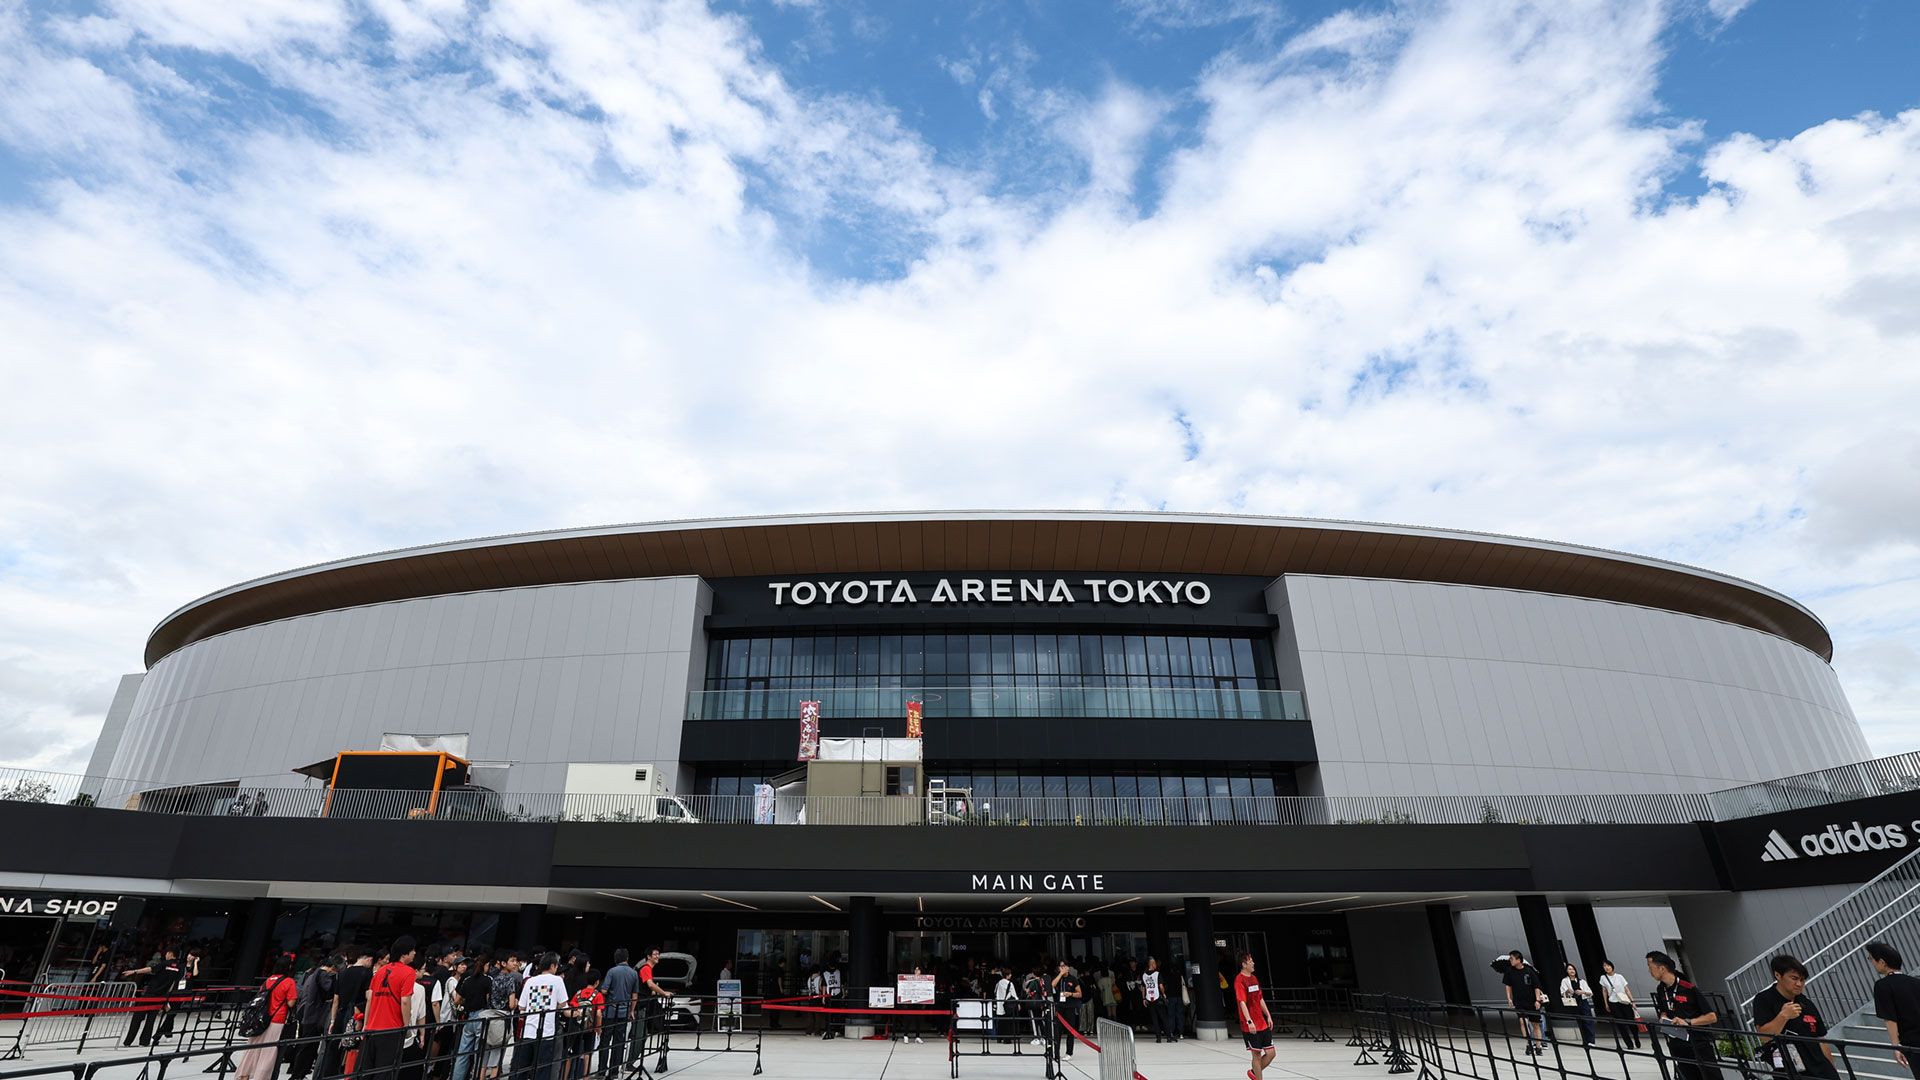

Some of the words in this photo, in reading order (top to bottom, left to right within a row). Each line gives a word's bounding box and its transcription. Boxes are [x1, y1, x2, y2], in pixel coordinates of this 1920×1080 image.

[769, 579, 917, 605] TOYOTA
[931, 578, 1075, 604] ARENA
[1084, 579, 1211, 605] TOKYO
[1800, 821, 1908, 857] adidas
[972, 874, 1033, 890] MAIN
[1043, 874, 1104, 890] GATE
[44, 899, 118, 916] SHOP
[915, 917, 973, 929] TOYOTA
[978, 917, 1032, 929] ARENA
[1036, 917, 1086, 929] TOKYO
